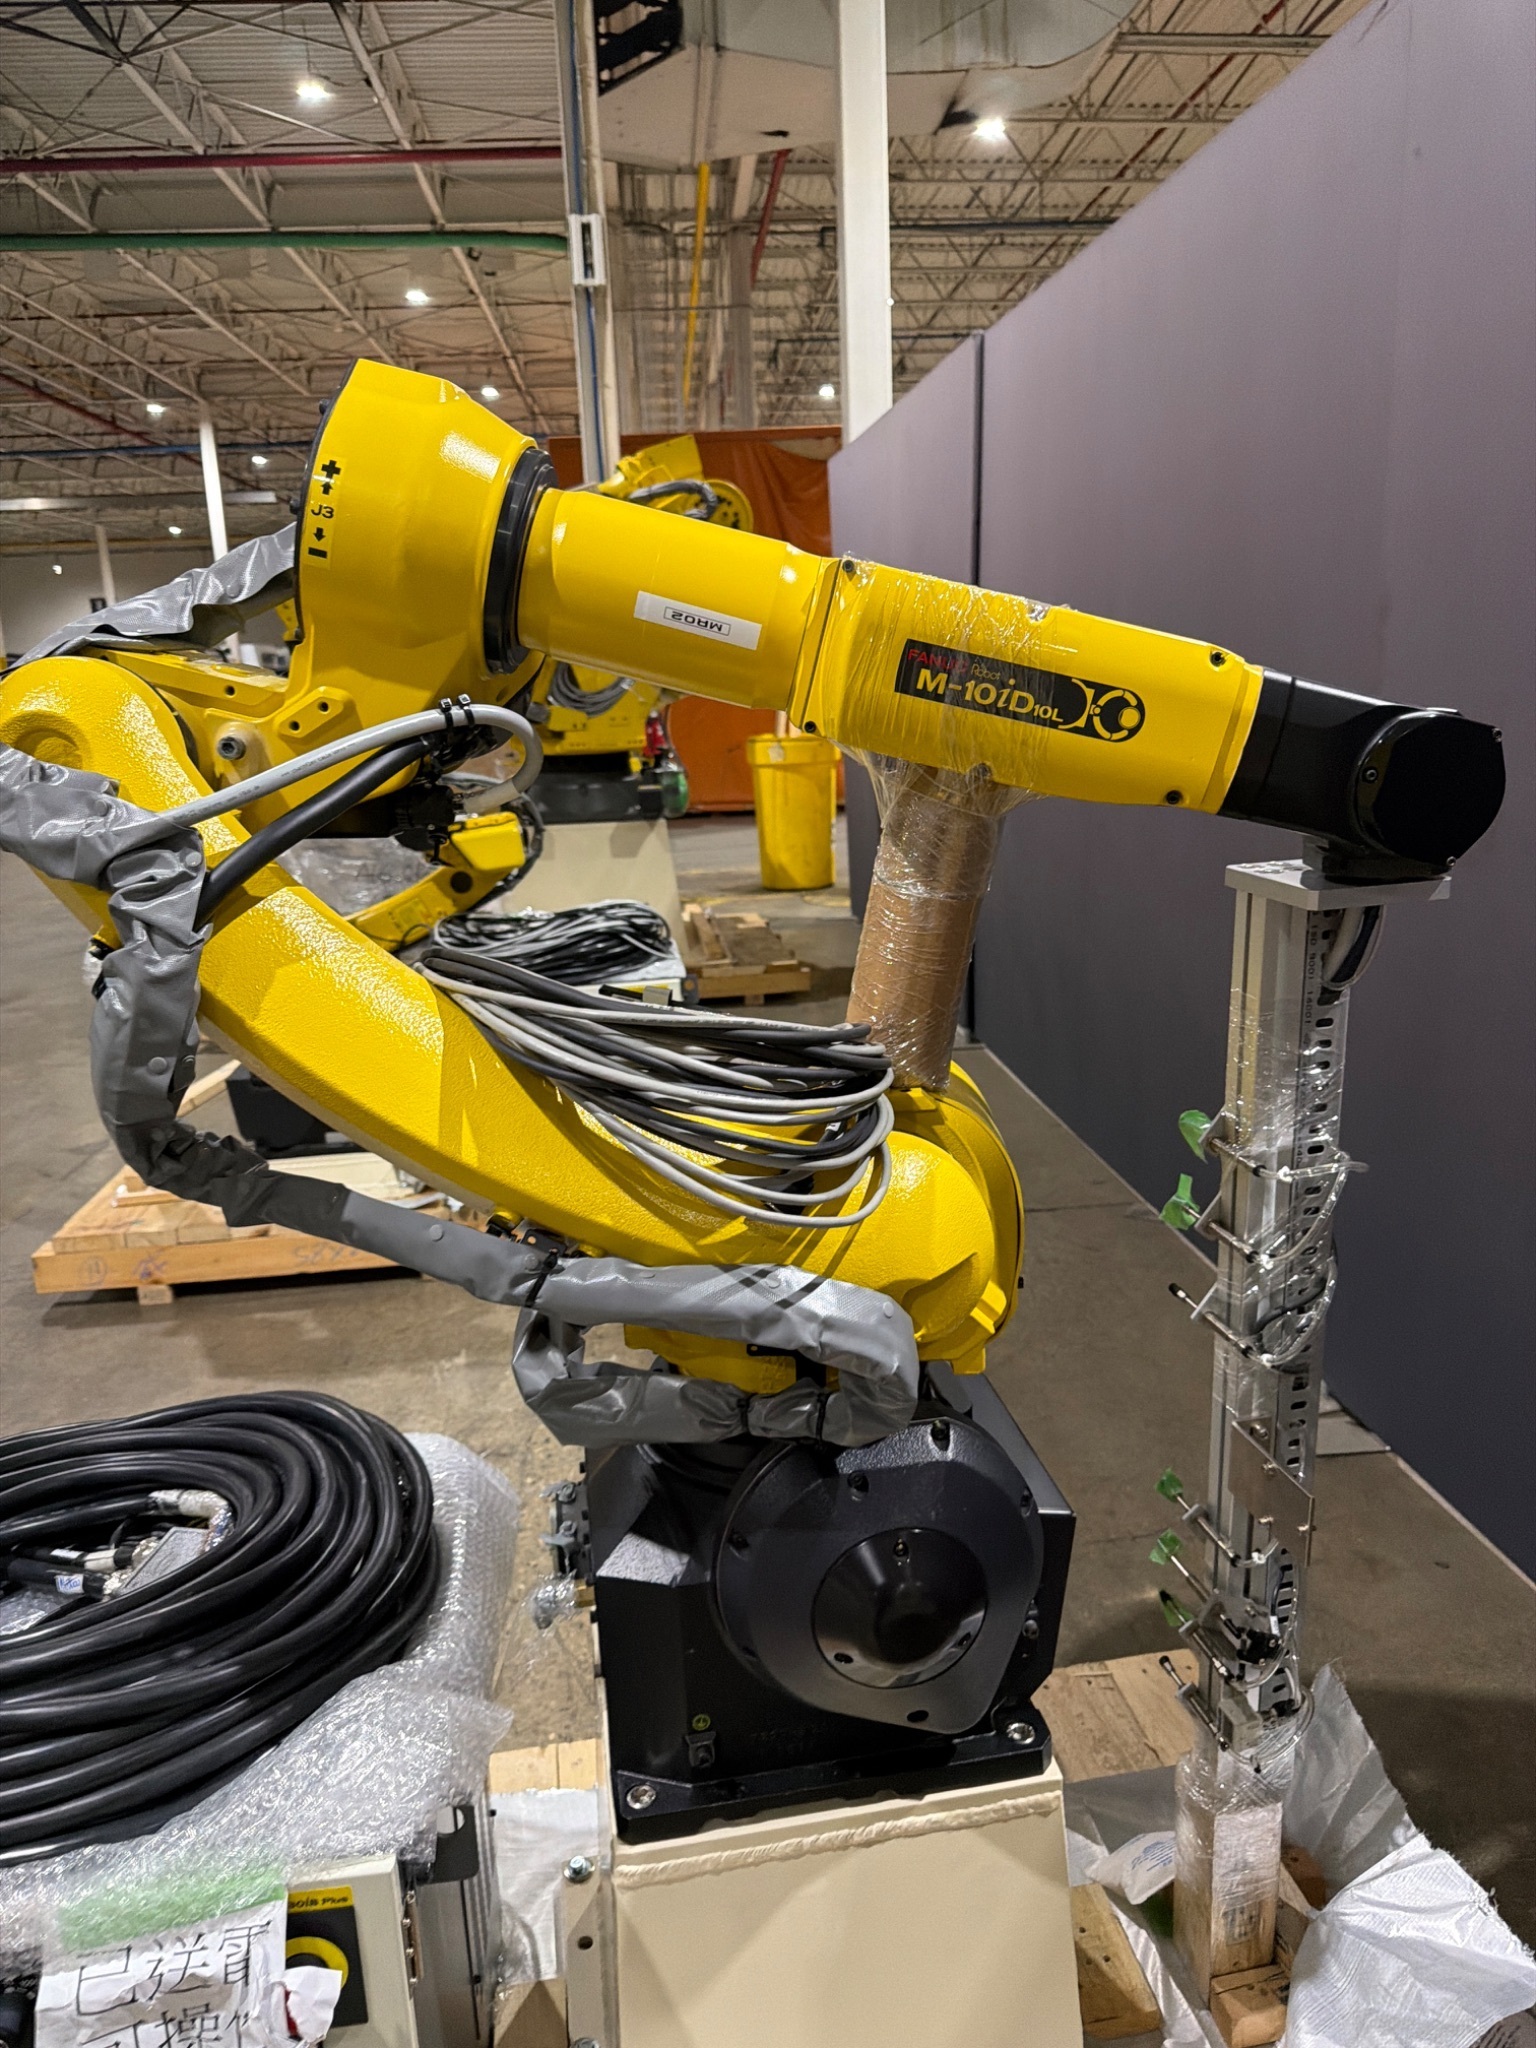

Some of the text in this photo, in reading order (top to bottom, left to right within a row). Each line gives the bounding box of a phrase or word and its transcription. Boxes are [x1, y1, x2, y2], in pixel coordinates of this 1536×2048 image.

[310, 504, 335, 519] J3
[670, 610, 723, 632] MR02
[907, 648, 968, 673] FANUC
